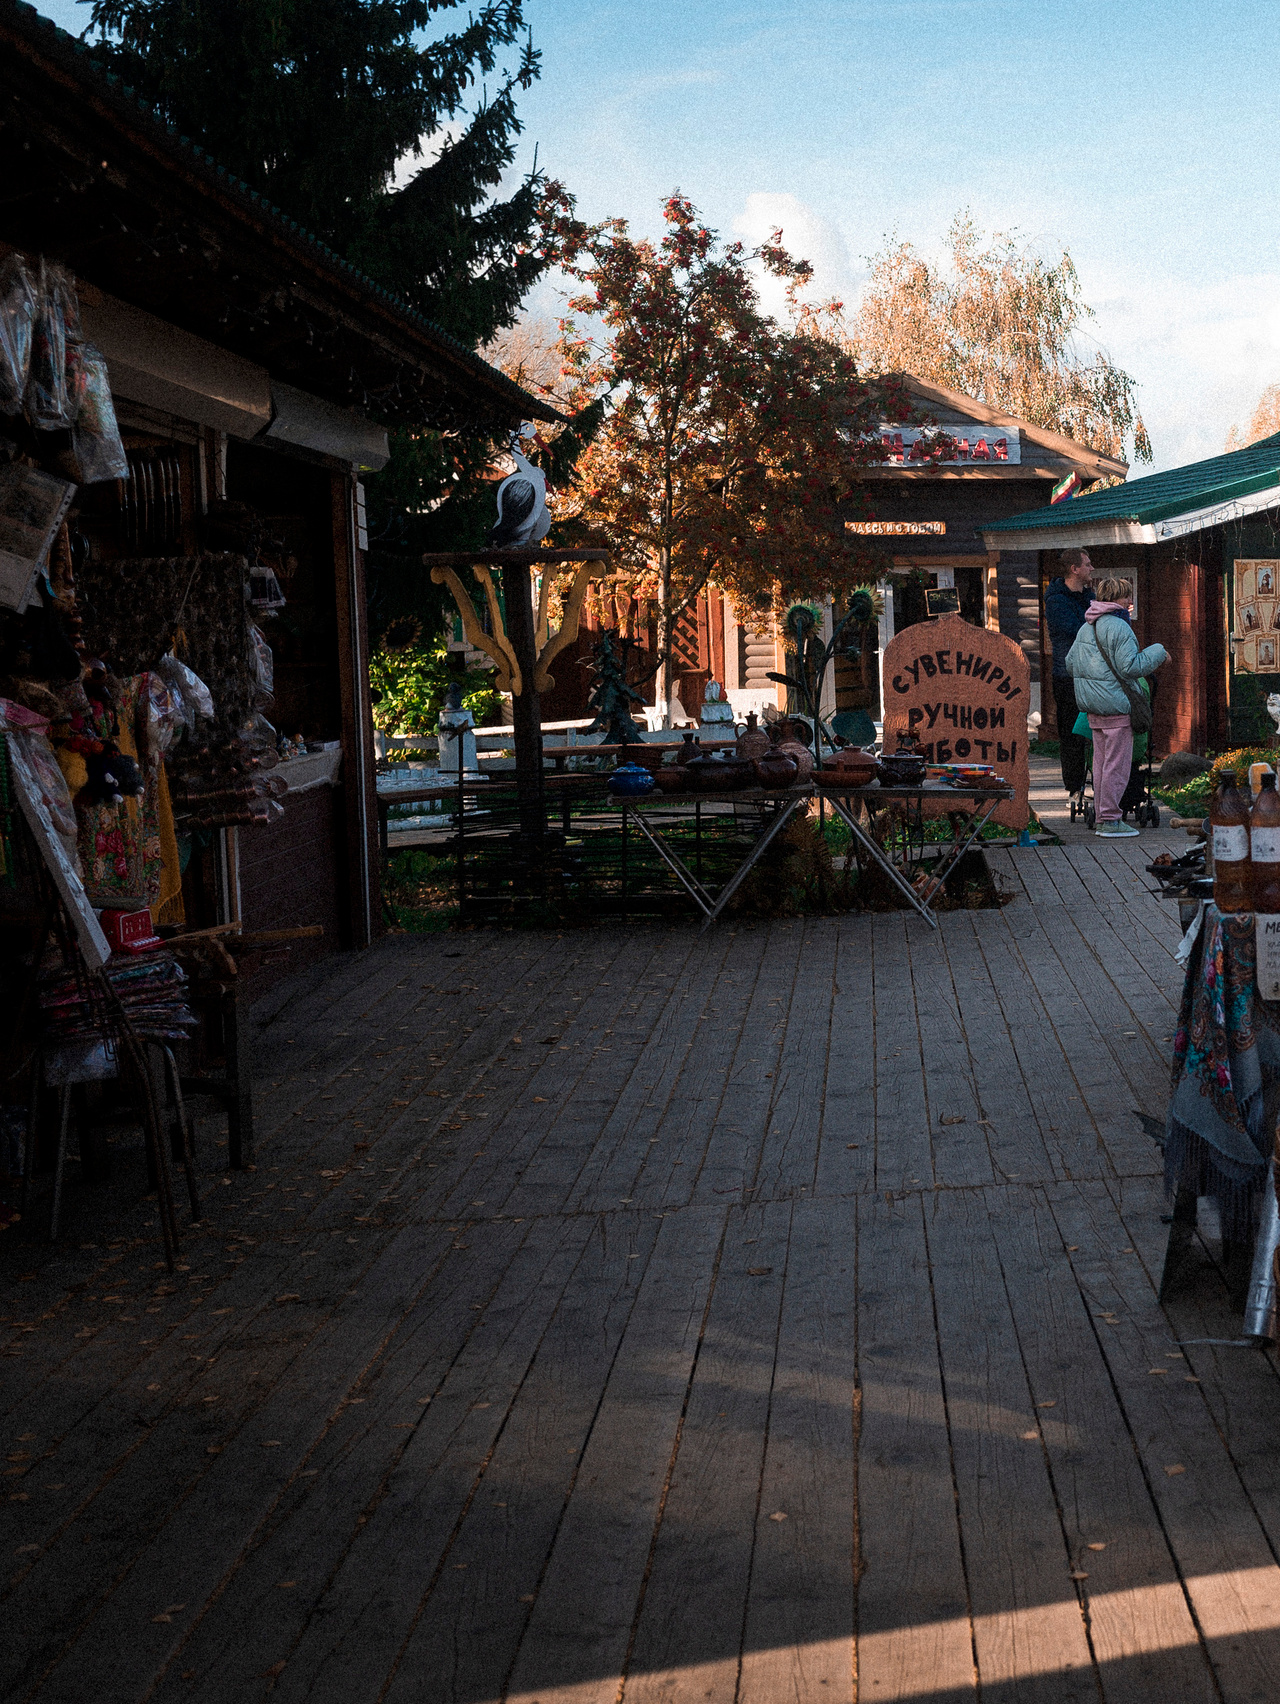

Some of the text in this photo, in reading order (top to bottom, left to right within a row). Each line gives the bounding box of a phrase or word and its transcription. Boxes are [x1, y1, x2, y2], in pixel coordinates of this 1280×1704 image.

[849, 523, 884, 534] ЗДЕСЬ
[892, 650, 1022, 701] СУВЕНИРЫ
[908, 702, 1005, 730] РУЧНОЙ
[922, 738, 1017, 767] АБОТЫ
